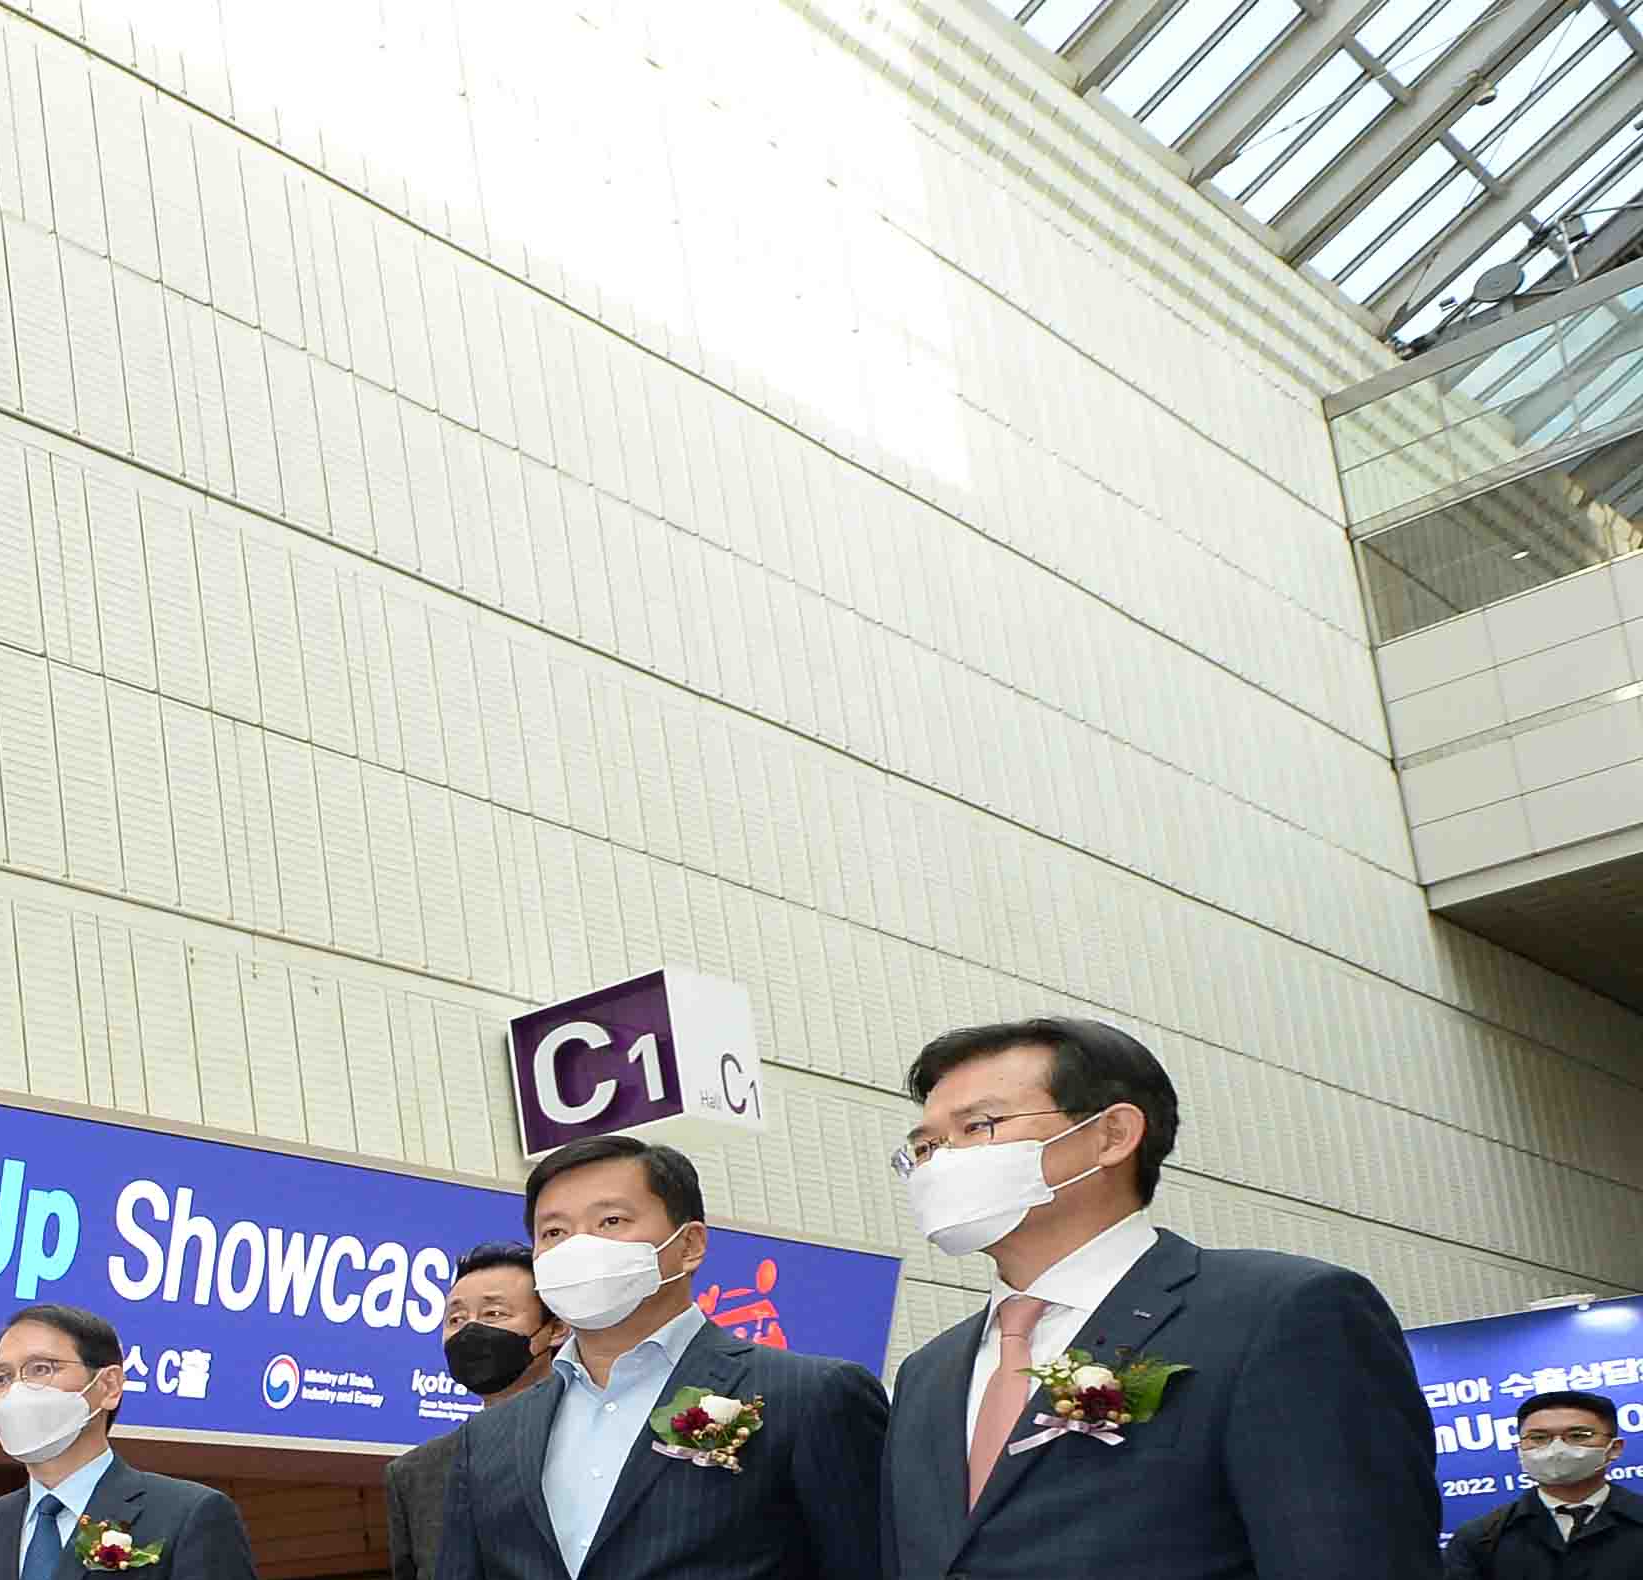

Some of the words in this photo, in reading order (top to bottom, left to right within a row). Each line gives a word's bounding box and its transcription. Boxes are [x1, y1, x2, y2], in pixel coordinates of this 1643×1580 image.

[534, 1021, 666, 1125] C1
[721, 1053, 761, 1120] C1
[107, 1178, 458, 1335] Showcas
[156, 1348, 213, 1400] C홀
[1442, 1476, 1498, 1497] 2022
